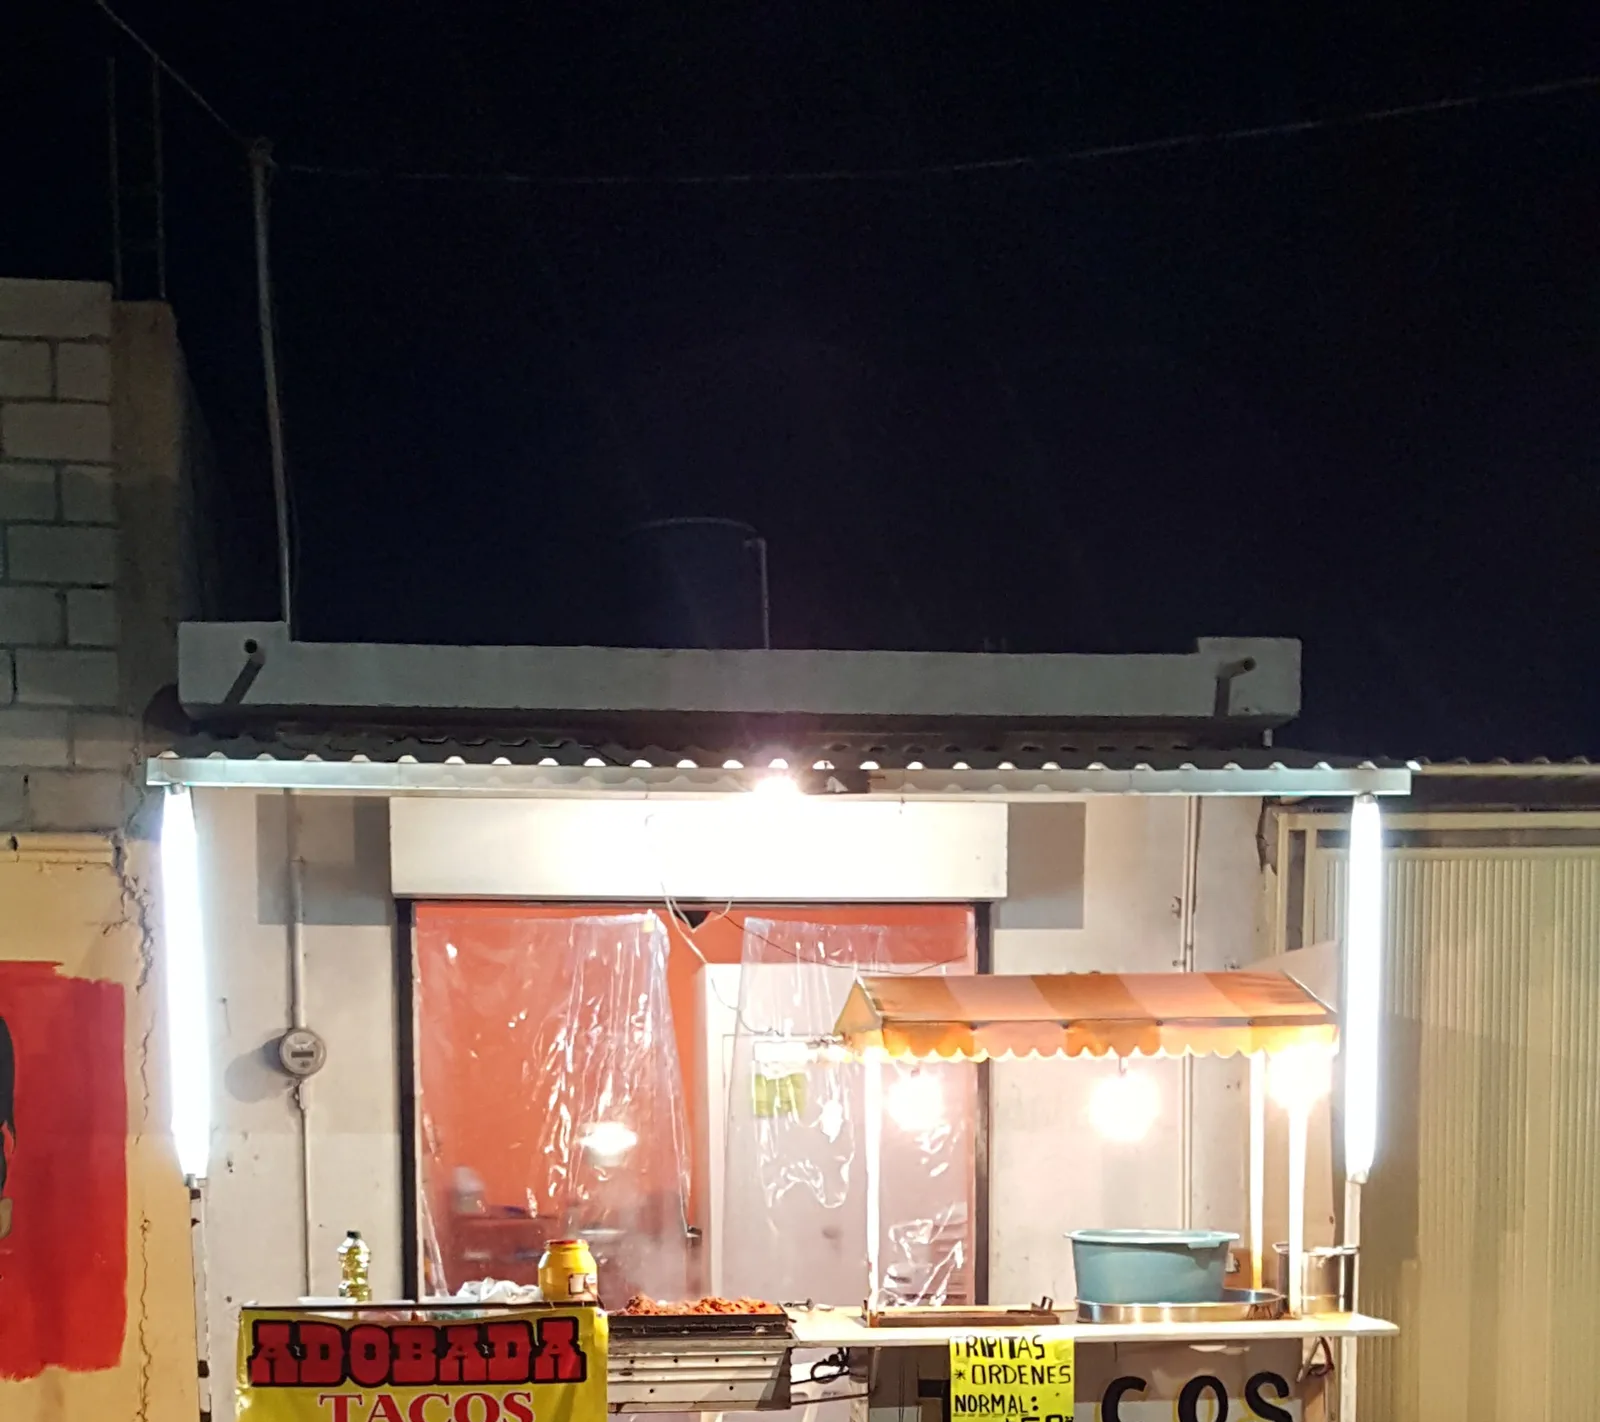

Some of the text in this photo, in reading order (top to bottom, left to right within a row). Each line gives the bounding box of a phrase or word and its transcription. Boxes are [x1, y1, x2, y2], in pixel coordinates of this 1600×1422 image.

[247, 1317, 587, 1388] ADOBADA
[972, 1364, 1071, 1385] ORDENES
[955, 1393, 1038, 1414] NORMAL:
